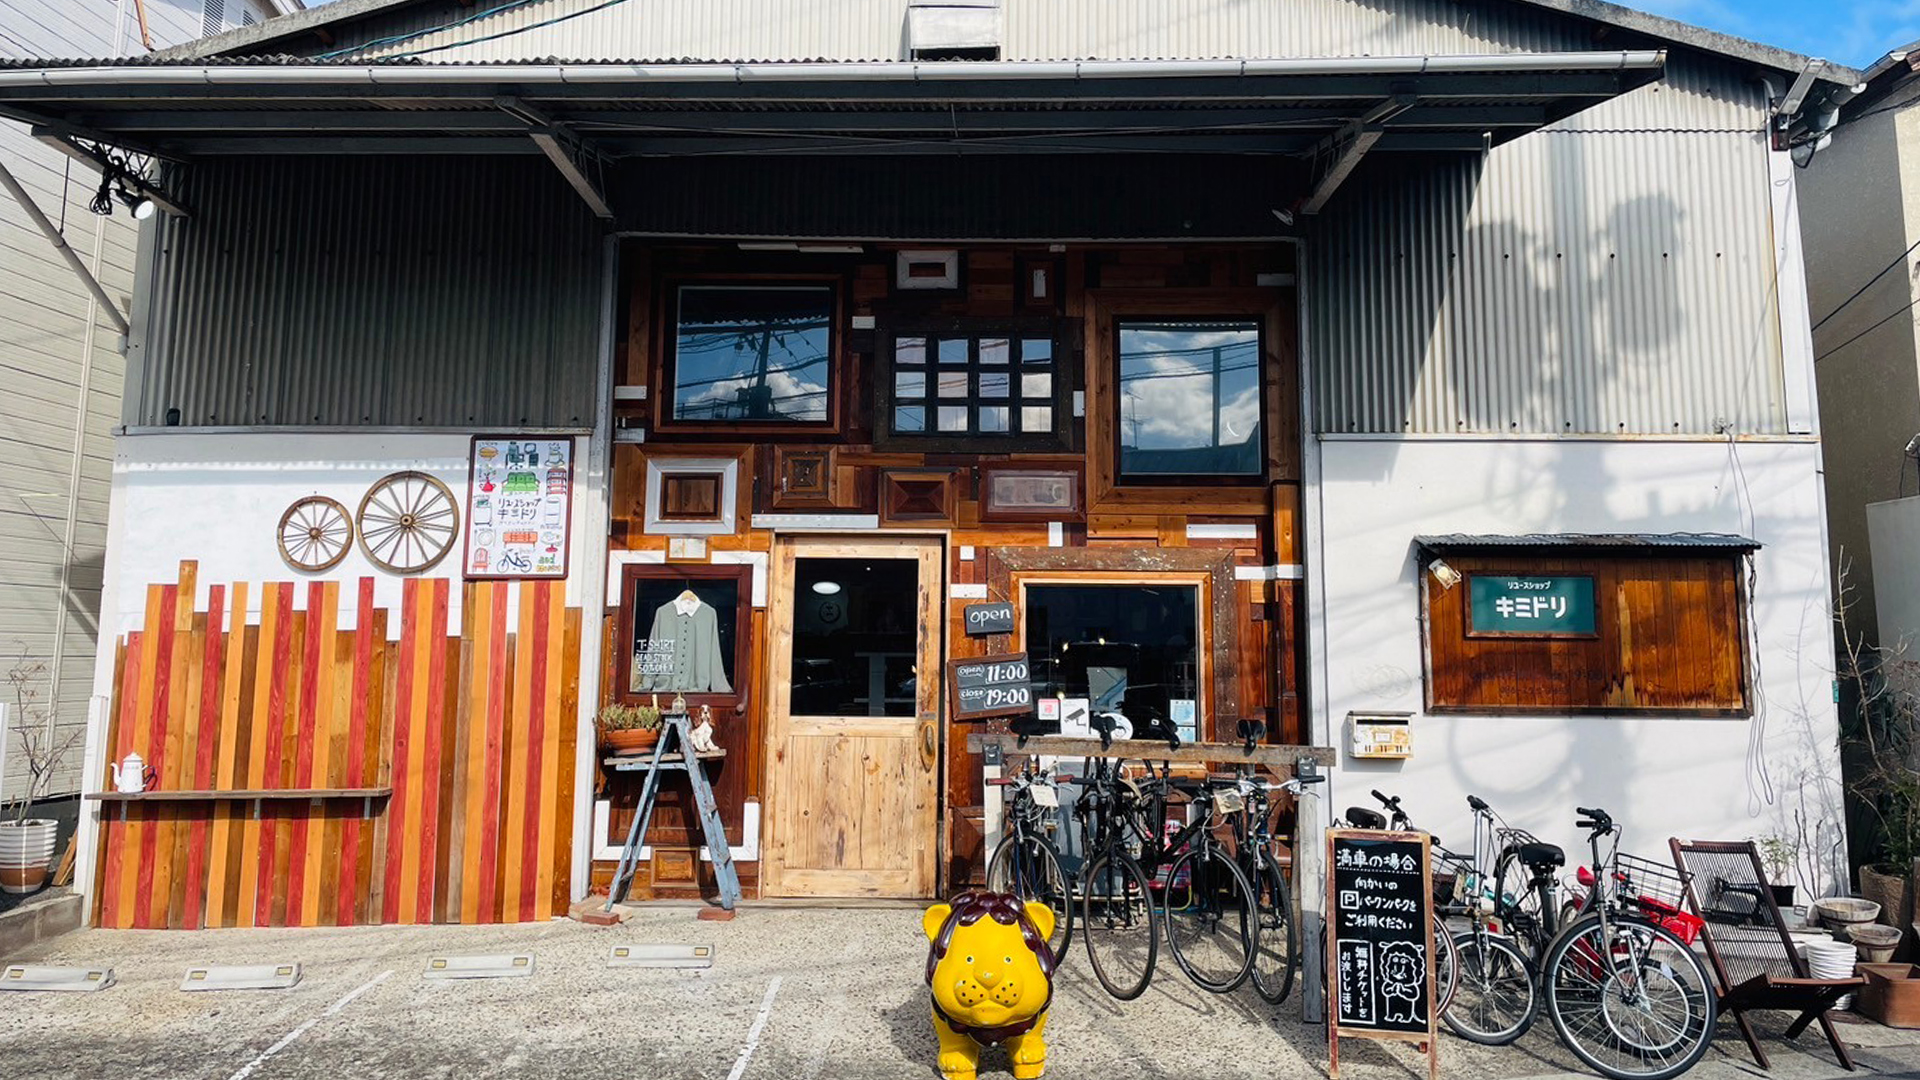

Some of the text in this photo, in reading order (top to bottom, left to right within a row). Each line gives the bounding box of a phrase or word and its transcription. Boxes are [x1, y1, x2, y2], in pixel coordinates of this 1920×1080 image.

[498, 508, 537, 520] キミドリ
[1507, 581, 1551, 590] リユースショップ
[1495, 596, 1566, 619] キミドリ
[970, 608, 1011, 627] open
[959, 664, 1027, 682] open 11:00
[960, 688, 1029, 706] close 19:00
[1336, 848, 1417, 871] 満車の場合
[1354, 876, 1398, 890] 向かいの
[1344, 913, 1413, 930] ご利用ください
[1341, 951, 1352, 1014] お渡しします
[1355, 946, 1368, 1018] 無料チケットを
